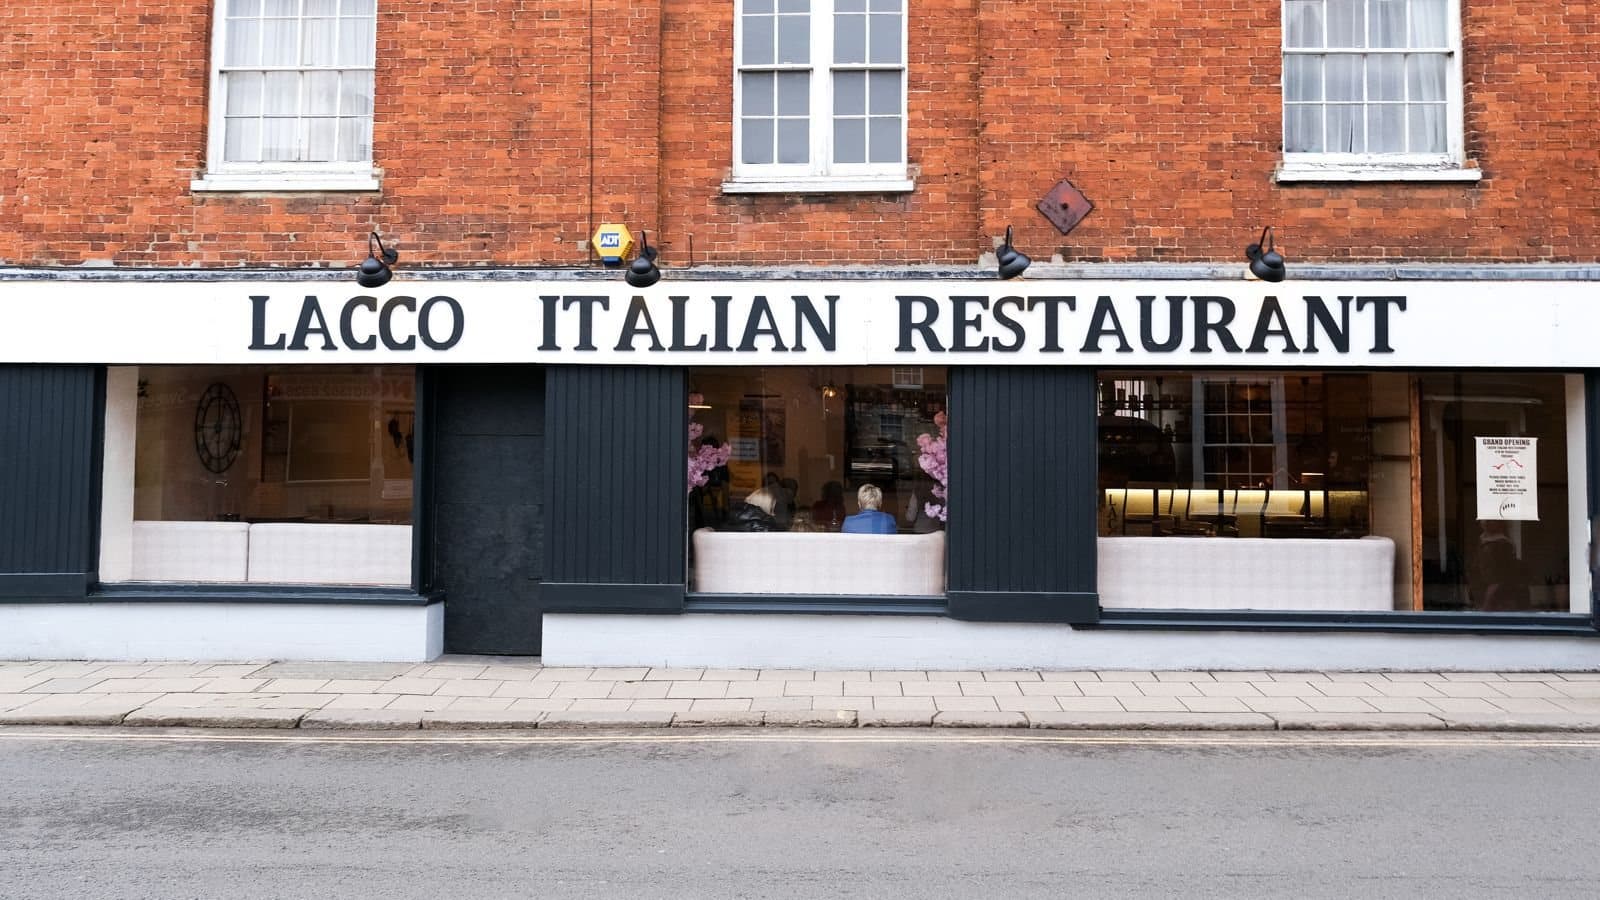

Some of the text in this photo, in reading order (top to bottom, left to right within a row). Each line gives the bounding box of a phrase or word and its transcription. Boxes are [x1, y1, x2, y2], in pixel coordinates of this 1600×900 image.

[601, 234, 620, 245] ADT
[248, 295, 1407, 354] LACCO ITALIAN RESTAURANT
